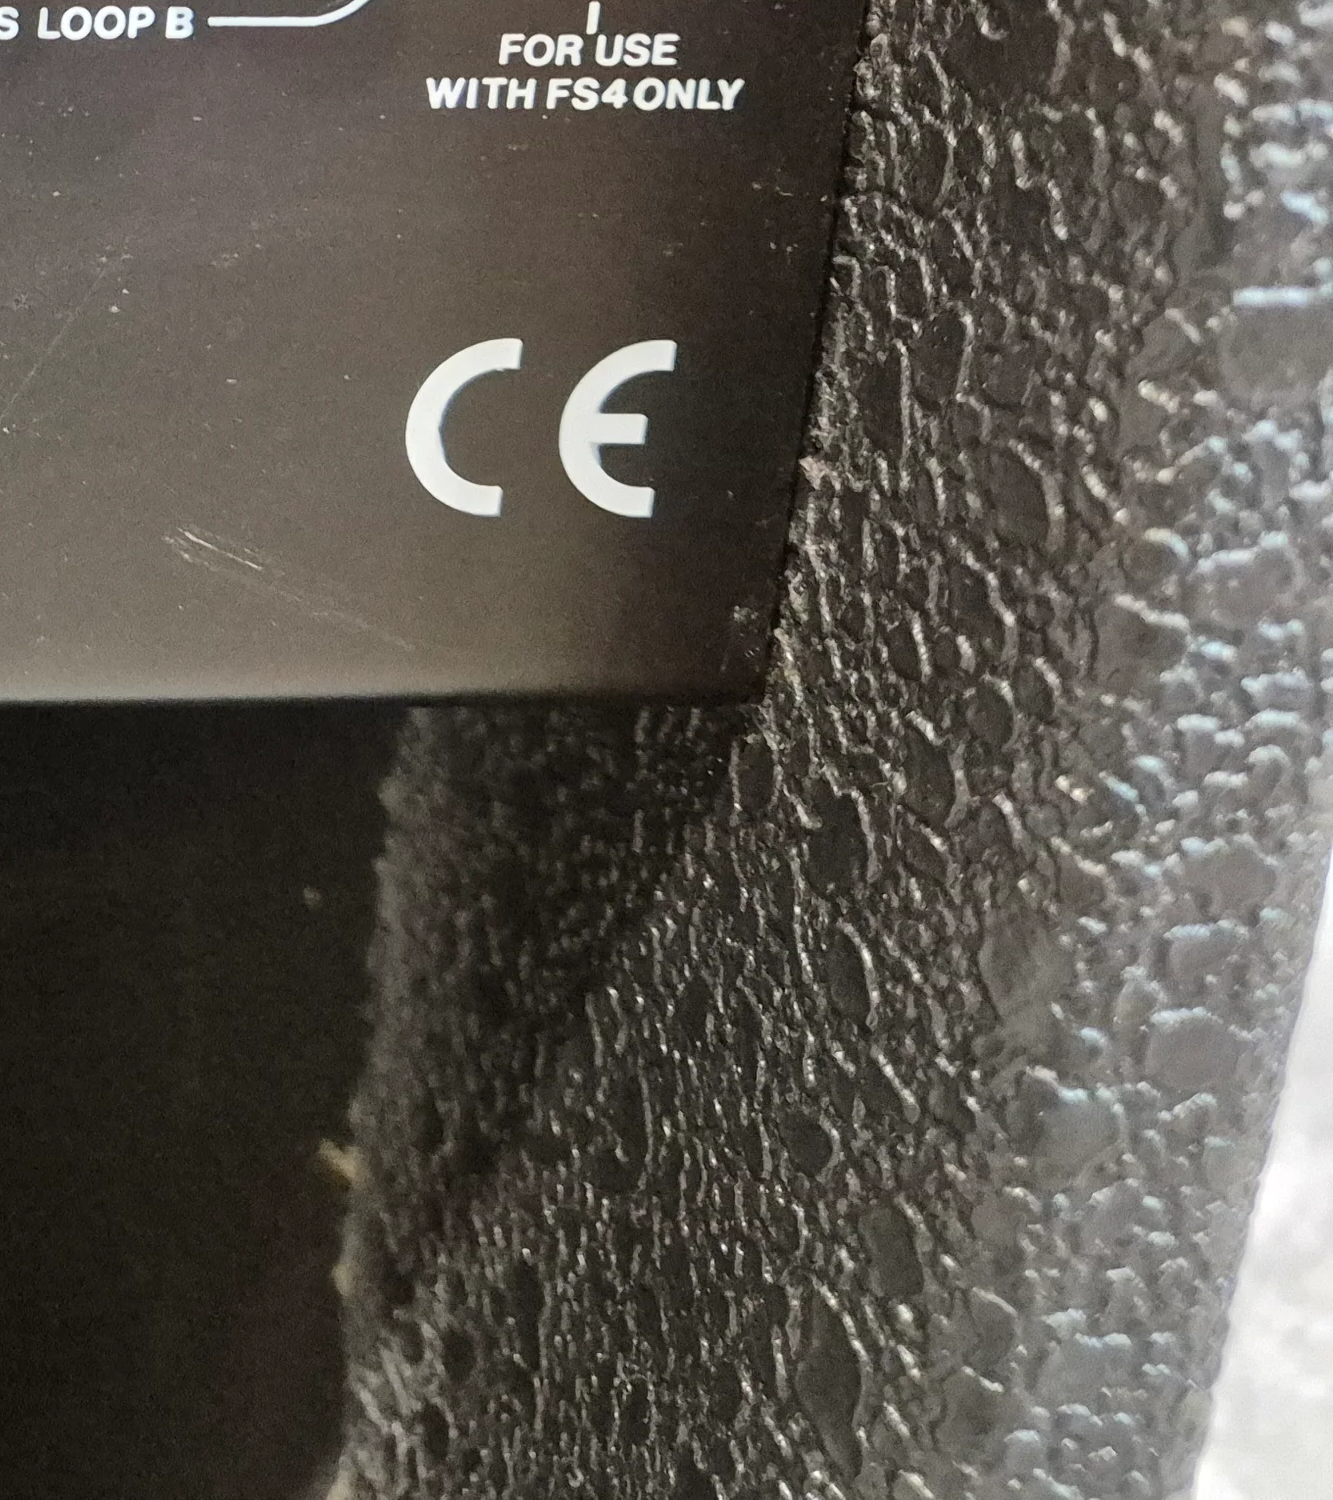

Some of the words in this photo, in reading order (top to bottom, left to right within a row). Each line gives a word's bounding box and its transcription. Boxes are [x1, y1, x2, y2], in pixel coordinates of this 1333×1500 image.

[37, 7, 157, 41] LOOP
[164, 8, 195, 41] B
[498, 33, 583, 67] FOR
[595, 33, 680, 67] USE
[426, 77, 537, 110] WITH
[546, 78, 628, 110] FS4
[634, 78, 745, 111] ONLY
[405, 338, 677, 518] CE
